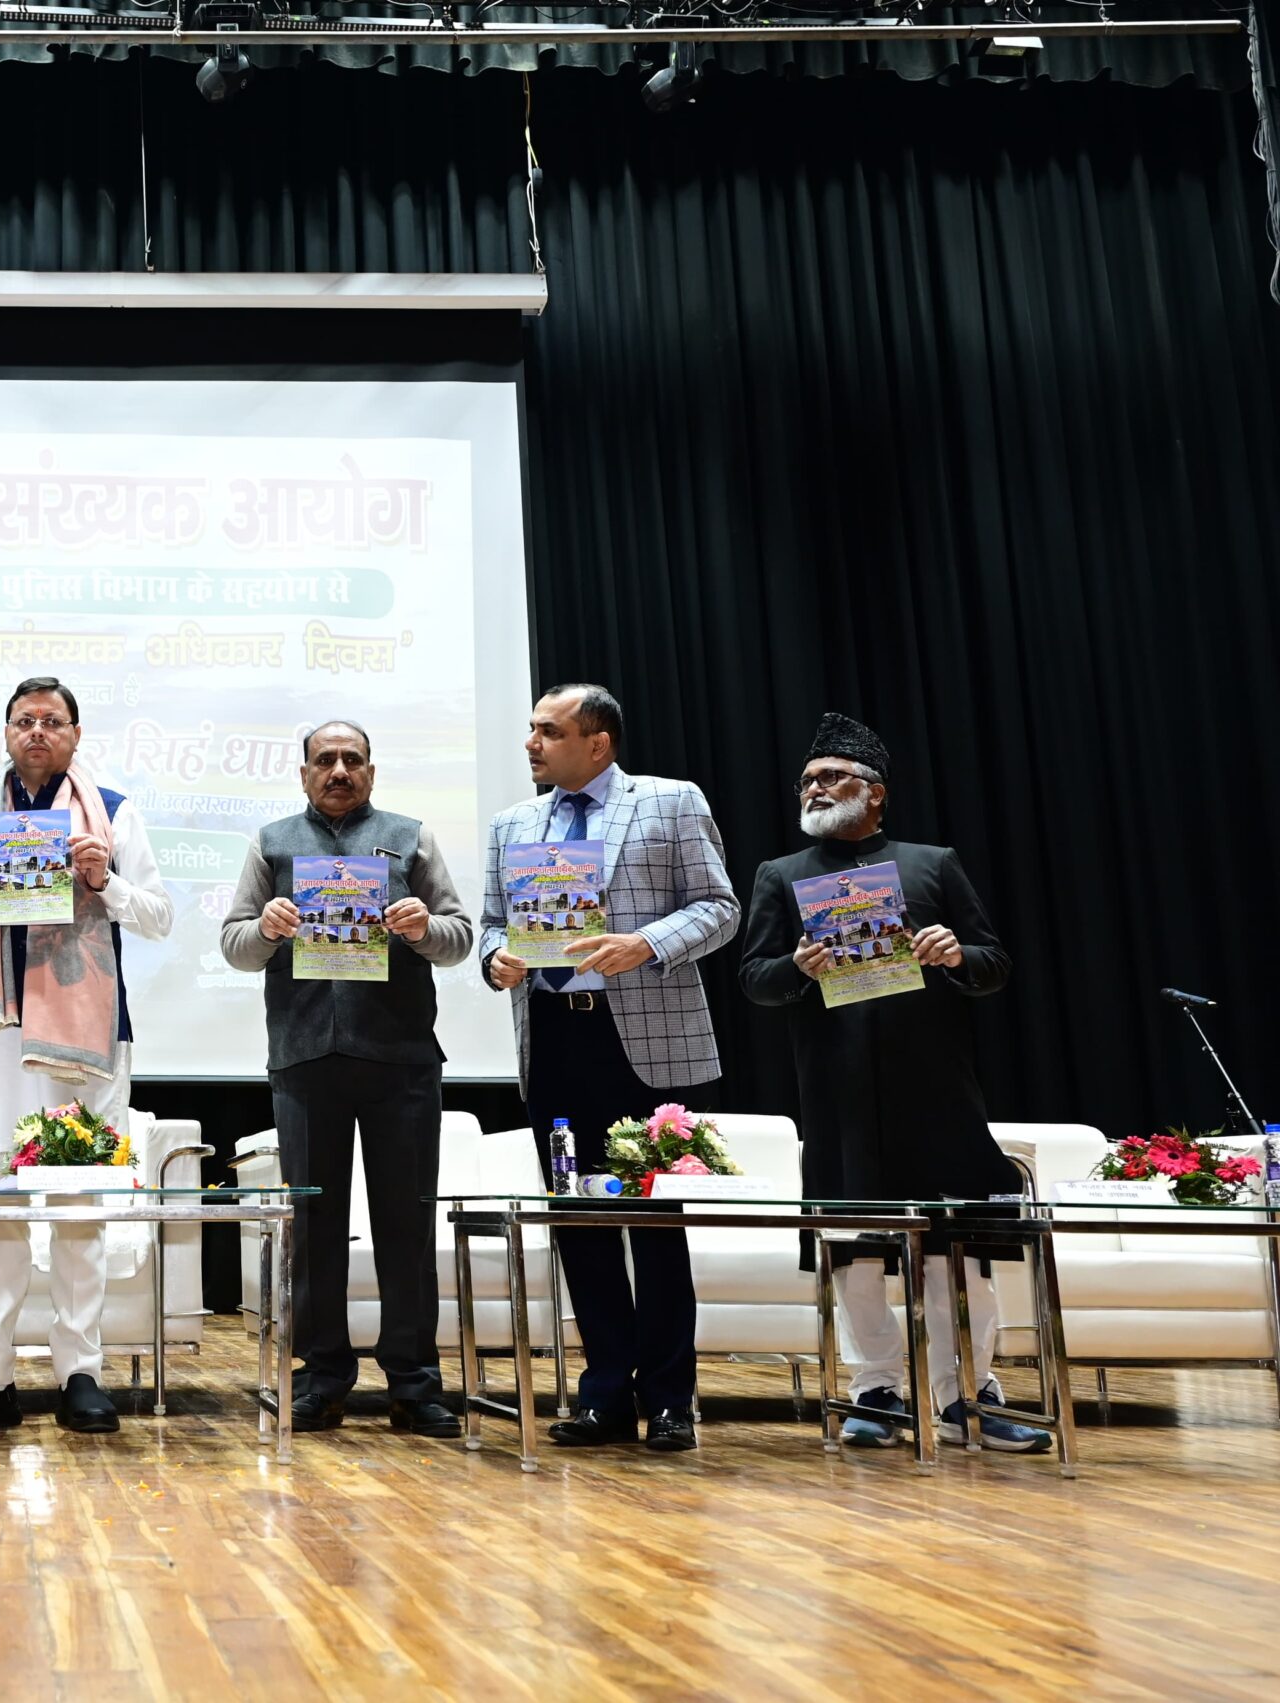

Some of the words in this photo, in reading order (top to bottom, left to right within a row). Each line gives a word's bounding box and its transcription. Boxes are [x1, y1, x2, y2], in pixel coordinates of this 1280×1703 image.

[221, 452, 431, 551] आयोग
[2, 567, 82, 609] पुलिस
[93, 569, 179, 603] विभाग
[186, 570, 215, 604] के
[221, 571, 319, 608] सहयोग
[326, 571, 352, 604] से
[145, 620, 285, 669] अधिकार
[161, 791, 257, 817] उत्तराखण्ड
